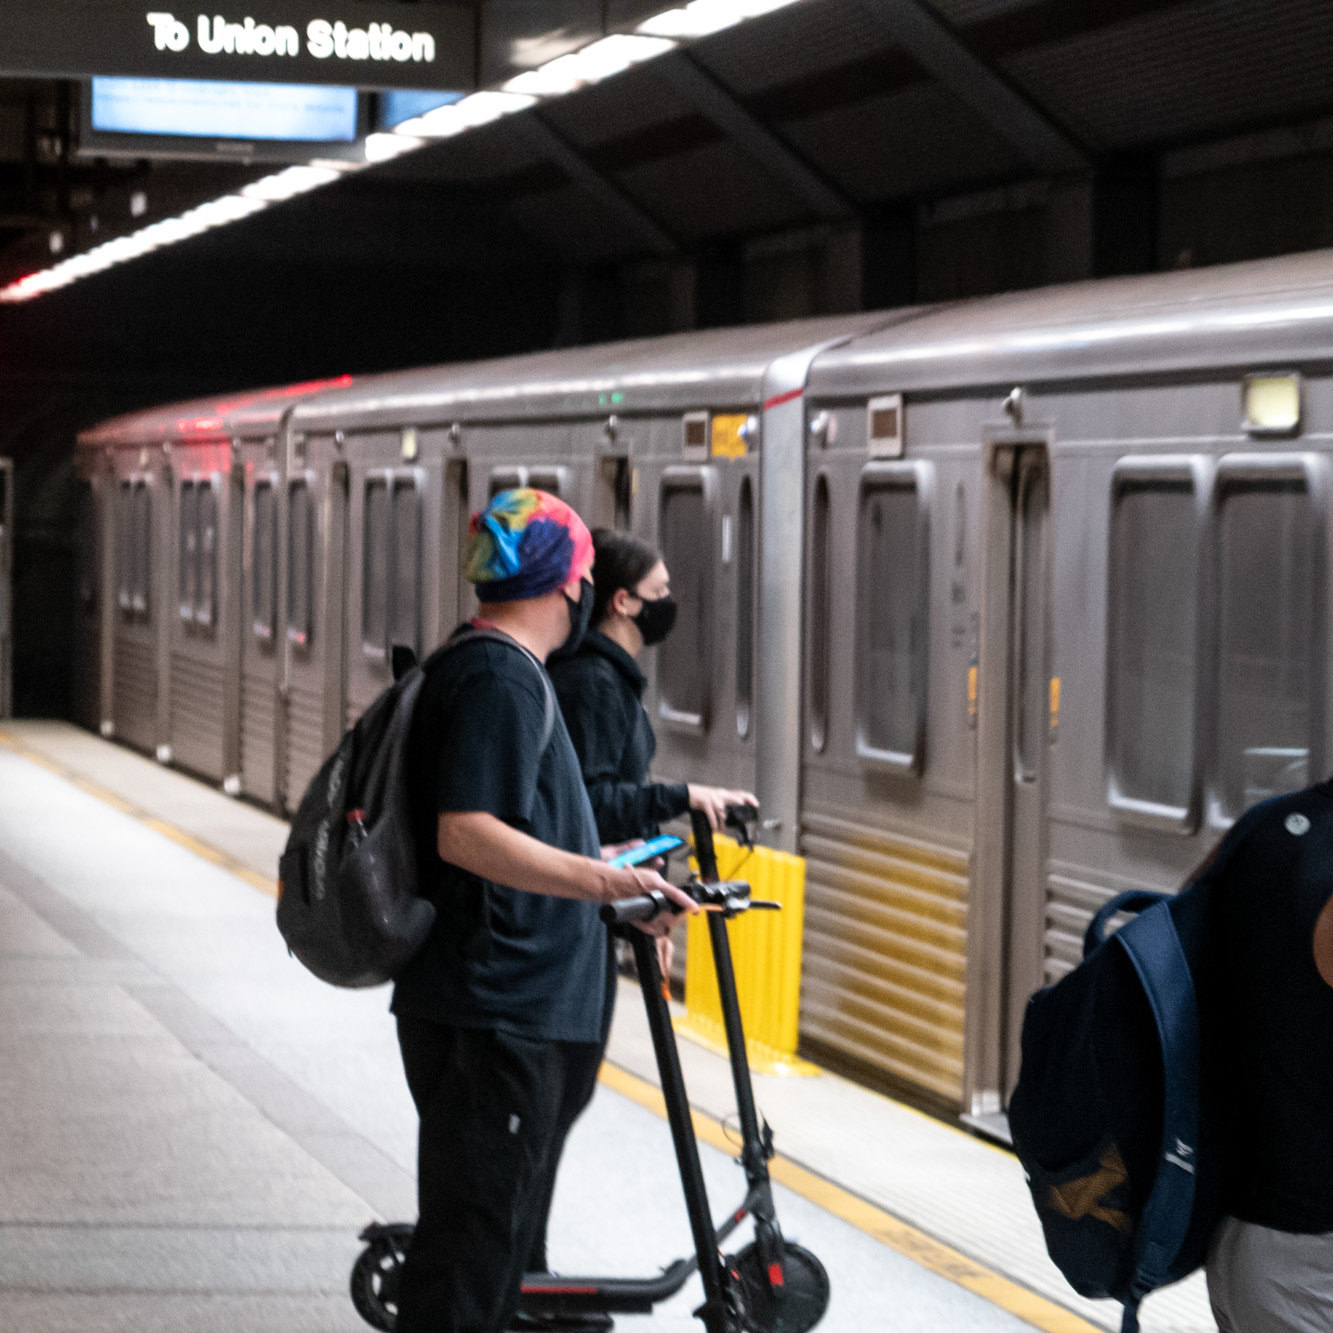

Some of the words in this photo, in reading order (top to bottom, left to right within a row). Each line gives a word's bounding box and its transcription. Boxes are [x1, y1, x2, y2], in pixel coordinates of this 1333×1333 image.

[147, 12, 190, 51] To
[197, 14, 300, 56] Union
[306, 18, 436, 62] Station
